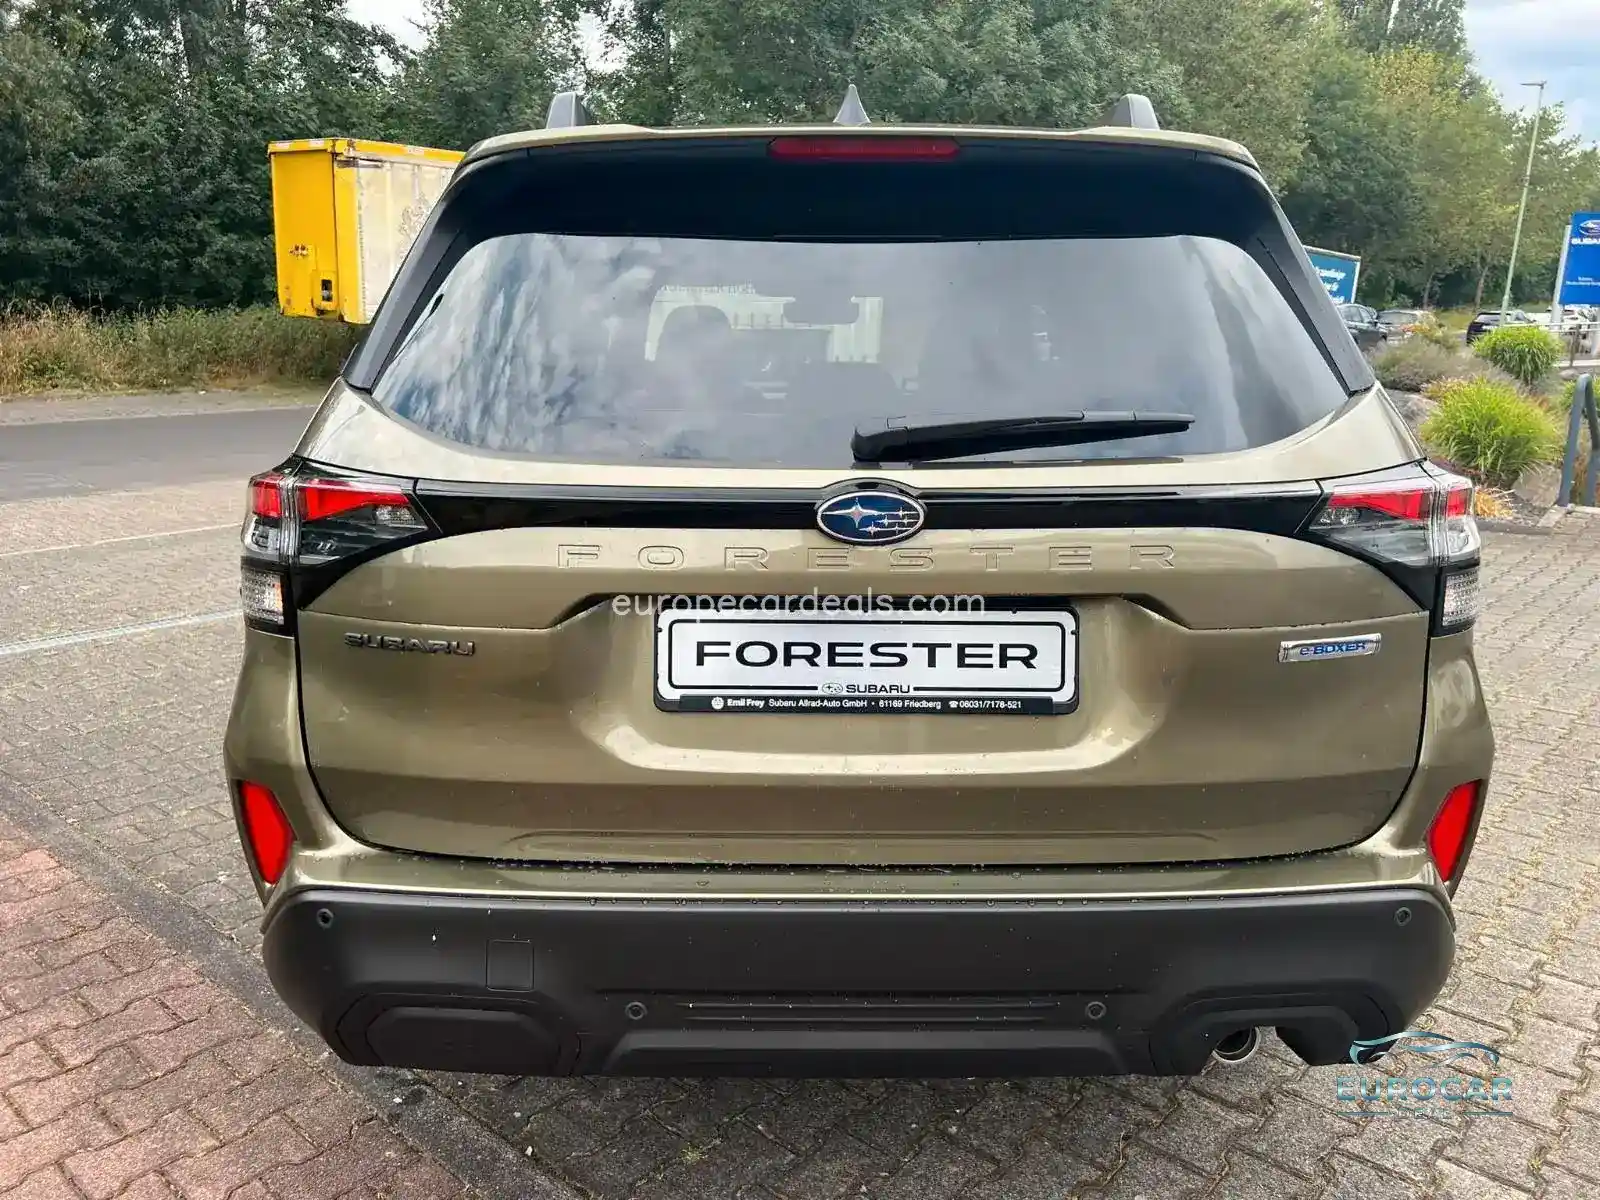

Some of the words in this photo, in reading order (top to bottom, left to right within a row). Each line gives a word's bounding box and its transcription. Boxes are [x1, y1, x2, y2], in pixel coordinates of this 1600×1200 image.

[1571, 237, 1600, 245] SUBA
[557, 544, 1175, 572] FORESTER
[344, 632, 475, 656] SUBARU
[1300, 641, 1366, 656] e-BOXER
[695, 640, 1038, 669] FORESTER
[846, 684, 911, 694] SUBARU
[727, 698, 746, 707] Emil
[746, 698, 765, 708] Frey
[768, 698, 797, 707] Subaru
[798, 698, 841, 708] Allrad-Auto
[842, 698, 868, 708] GmbH
[878, 699, 903, 708] 61169
[904, 699, 941, 710] Friedberg
